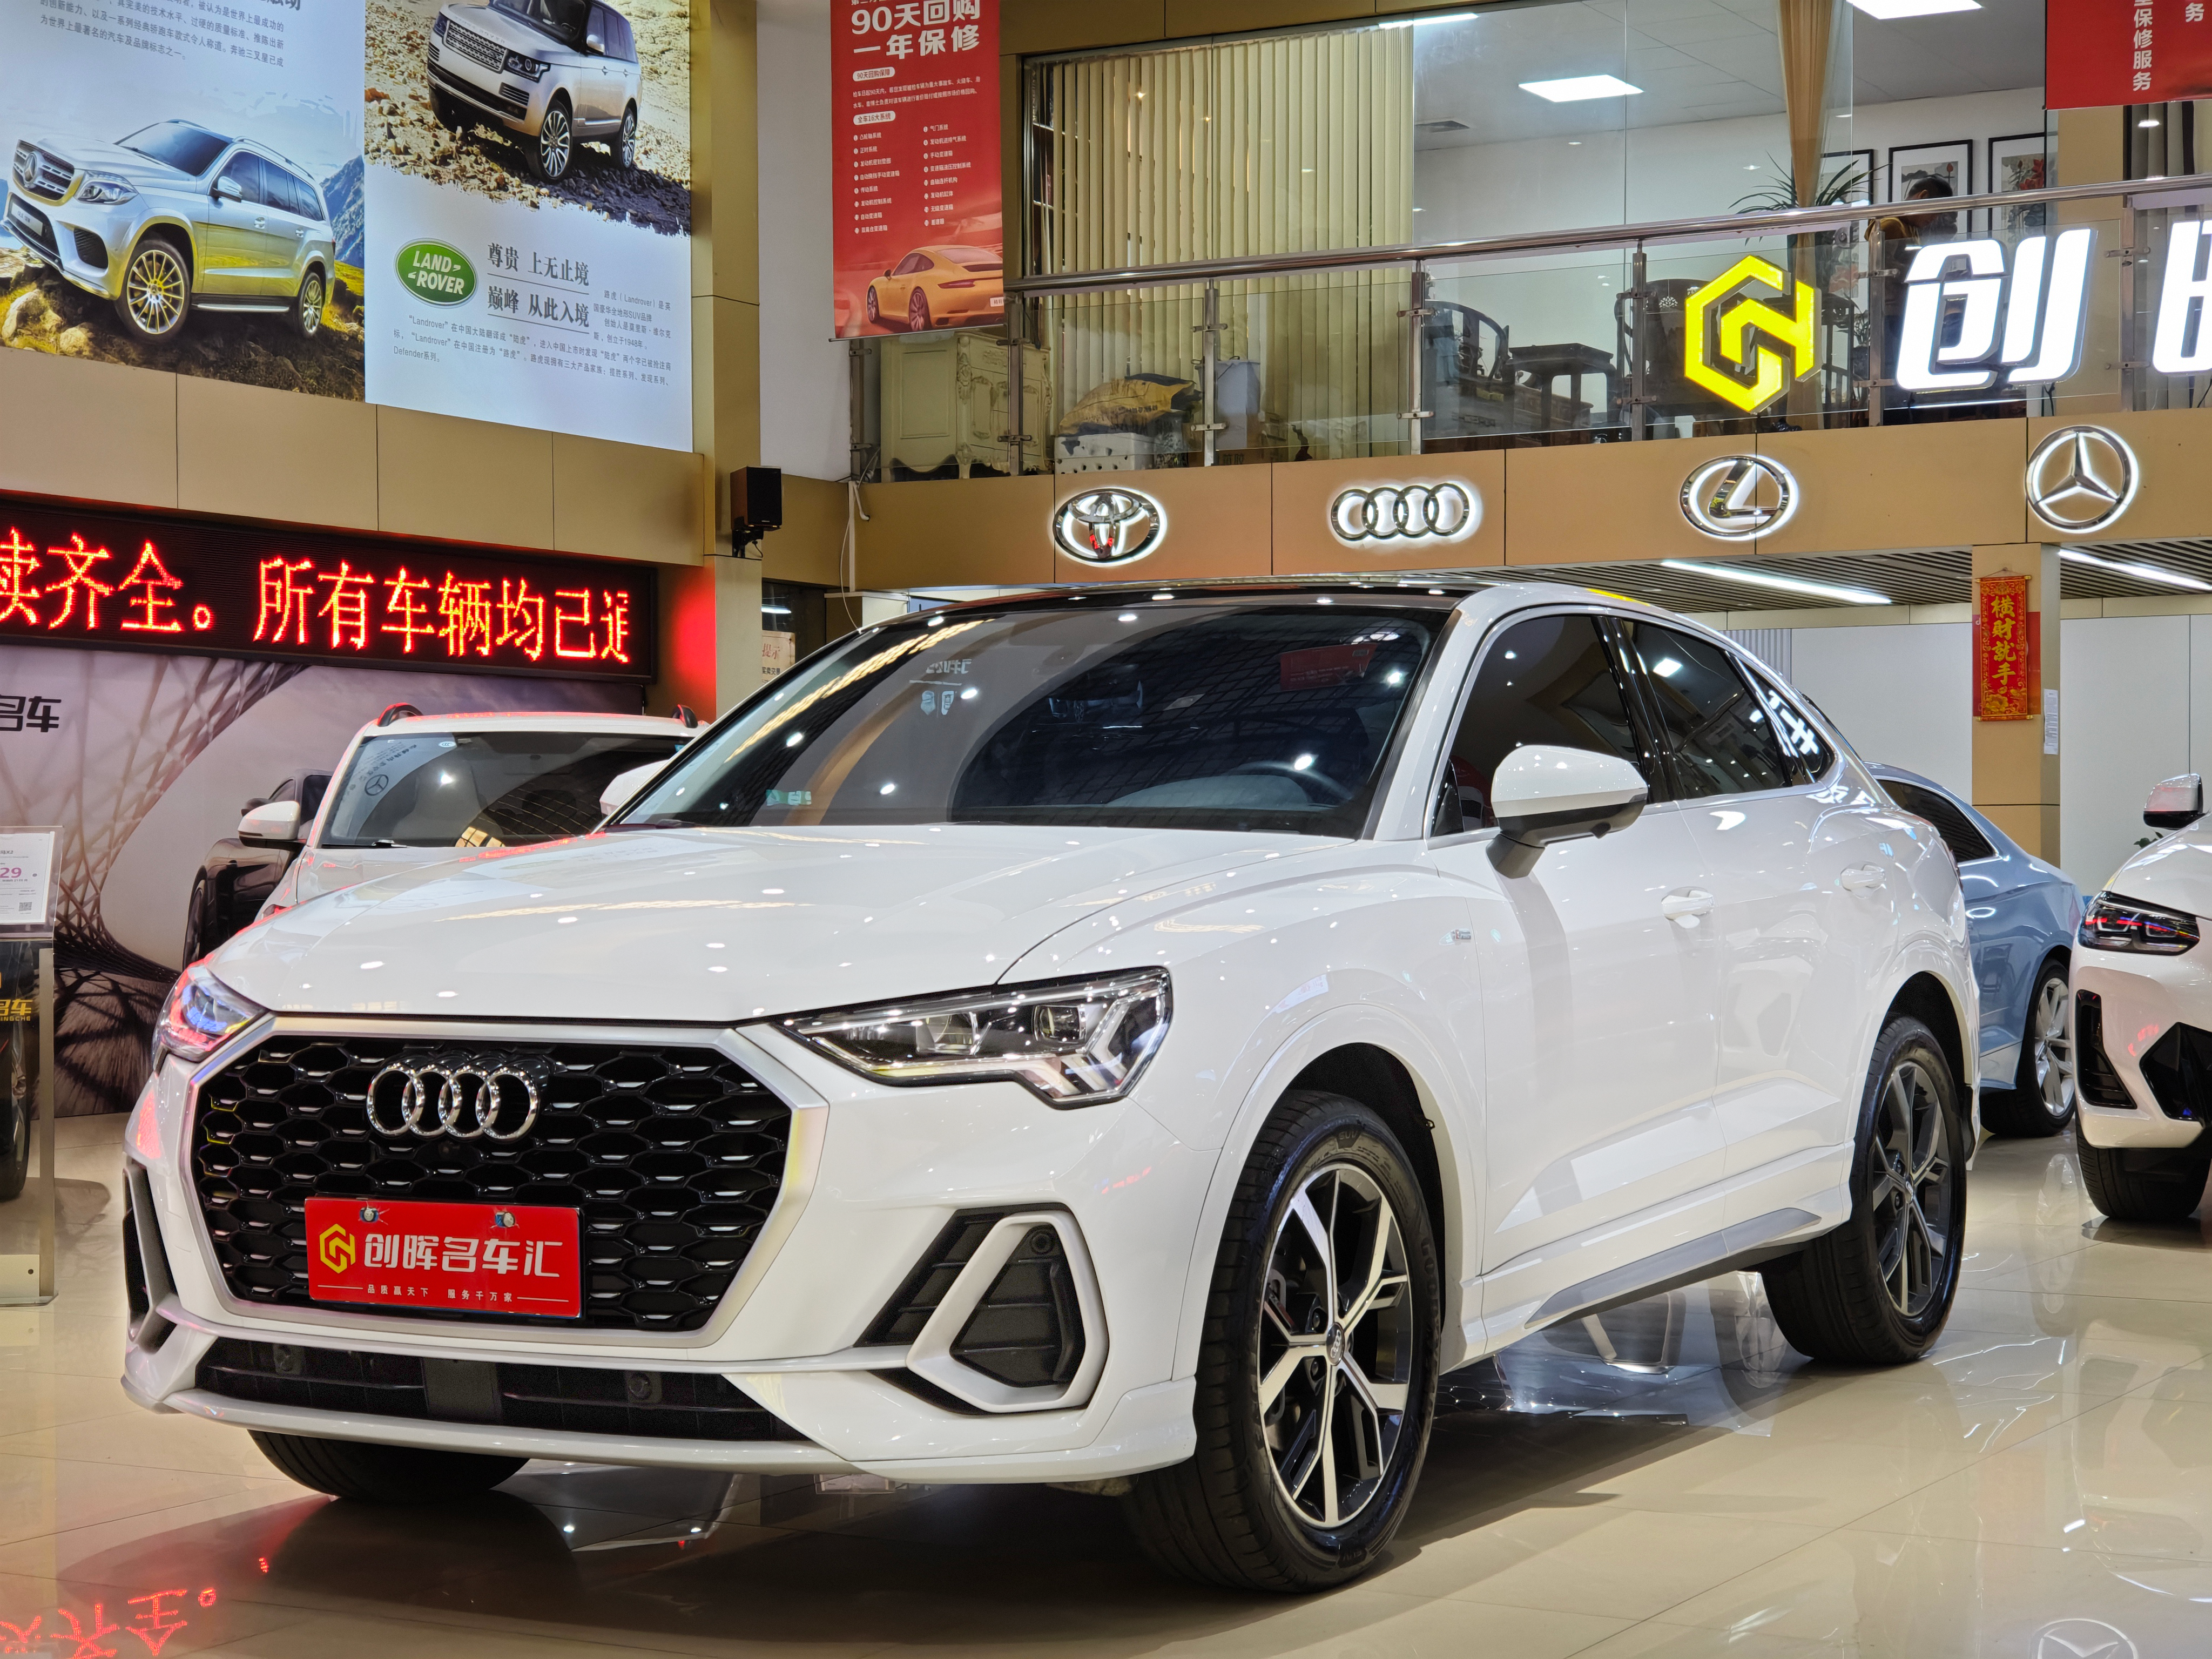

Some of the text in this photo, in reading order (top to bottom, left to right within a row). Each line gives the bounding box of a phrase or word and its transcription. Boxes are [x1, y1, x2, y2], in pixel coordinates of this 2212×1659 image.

[851, 0, 981, 35] 90天回购
[853, 25, 980, 59] 一年保修
[487, 242, 589, 286] 尊贵 上无止境
[416, 270, 464, 295] ROVER
[487, 286, 589, 327] 巅峰 从此入境
[593, 303, 652, 323] 国豪华全地形SUV品牌
[364, 1233, 563, 1277] 创晖名车汇
[367, 1284, 514, 1303] 品质赢天下 服务千万家
